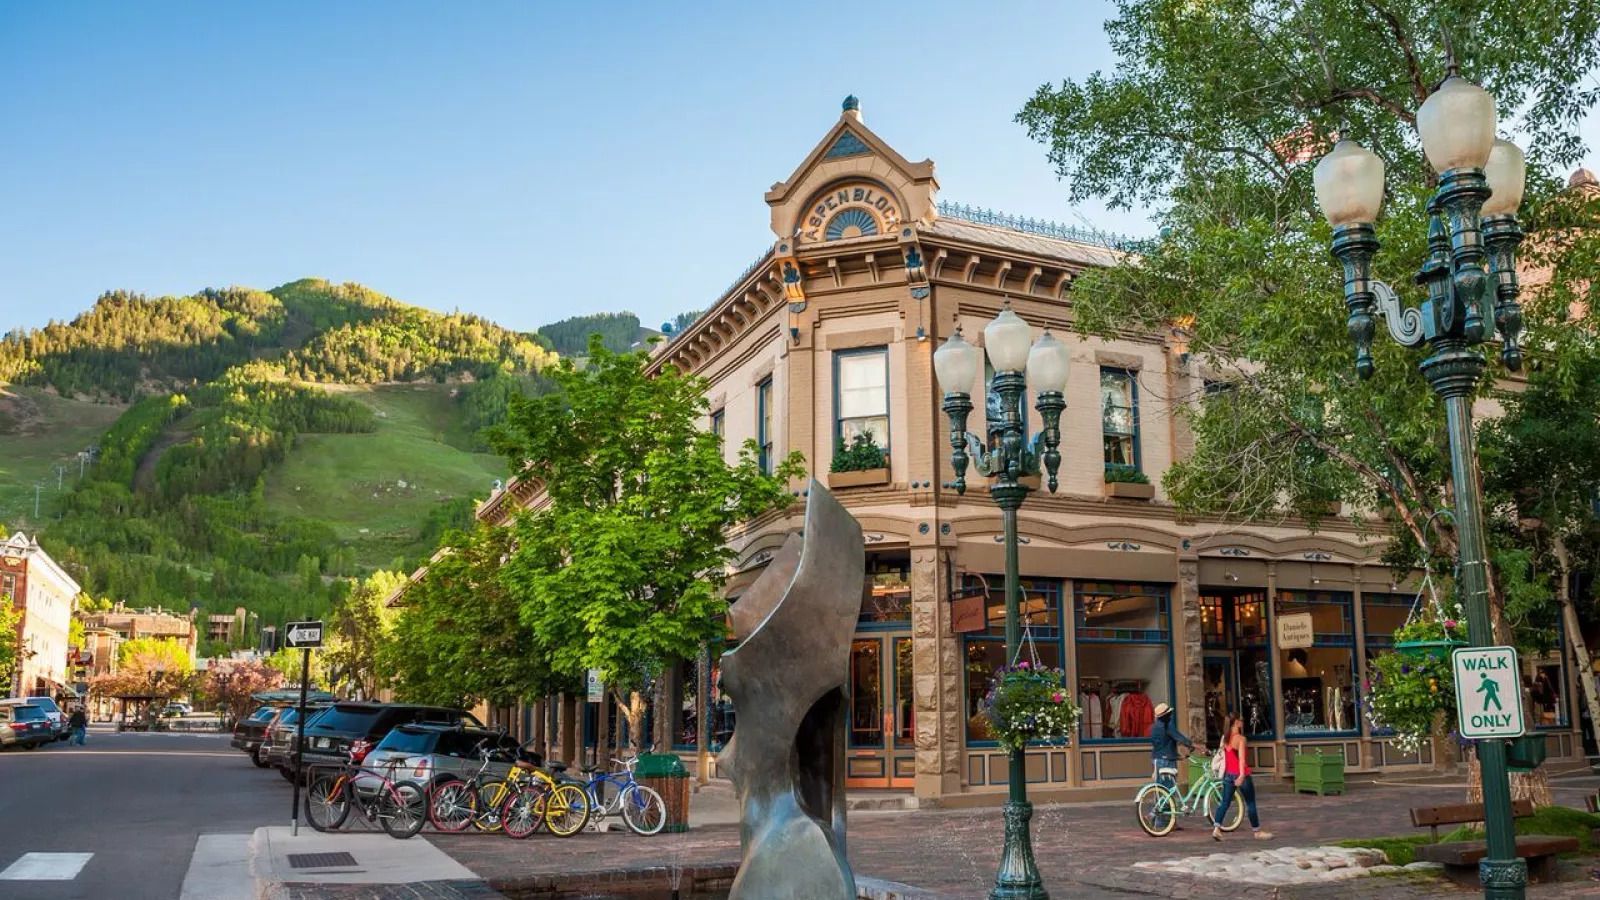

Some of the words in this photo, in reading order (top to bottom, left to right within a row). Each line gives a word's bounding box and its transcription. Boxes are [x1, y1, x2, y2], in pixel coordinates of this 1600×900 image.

[805, 189, 849, 240] ASPEN
[296, 631, 306, 640] ONE
[308, 631, 318, 639] WAY
[1282, 632, 1310, 643] Antiques
[1463, 657, 1508, 671] WALK
[1471, 713, 1512, 728] ONLY
